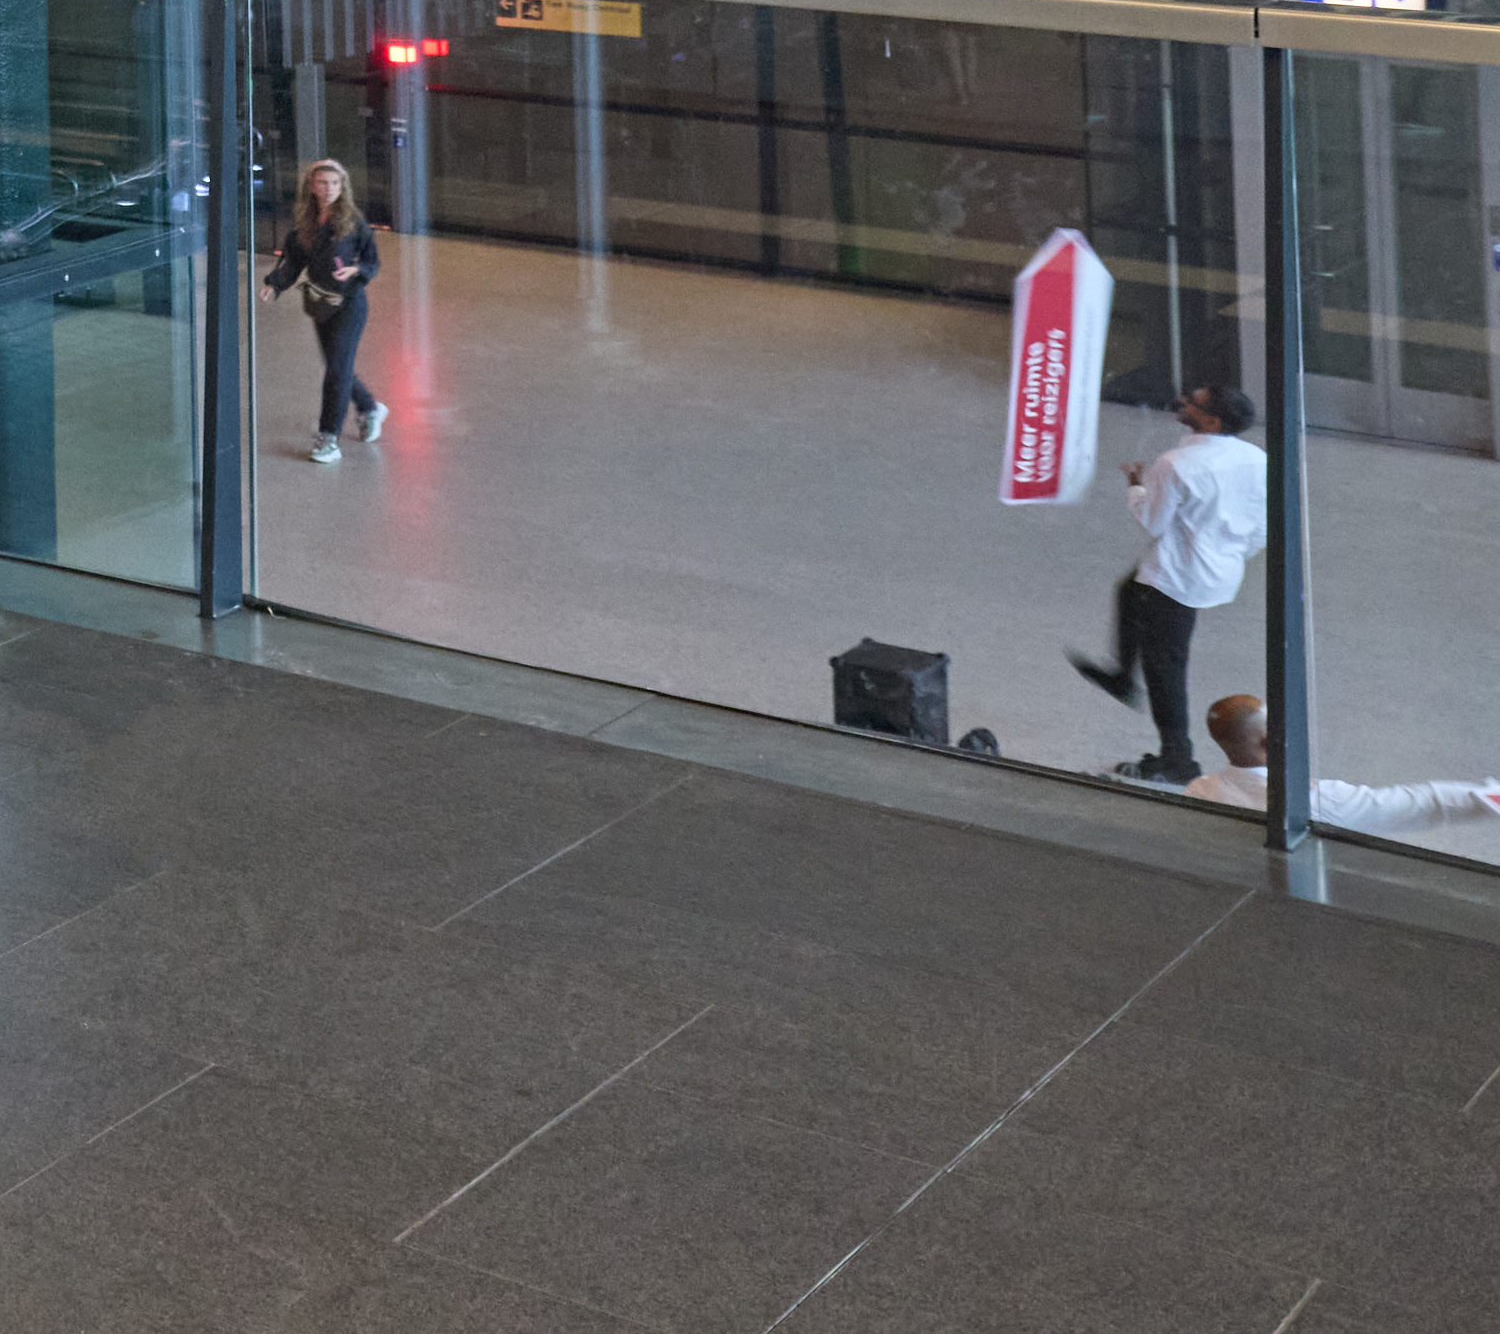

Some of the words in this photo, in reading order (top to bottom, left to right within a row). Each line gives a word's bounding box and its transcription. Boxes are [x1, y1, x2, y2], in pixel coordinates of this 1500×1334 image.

[1021, 341, 1045, 417] ruimte
[1040, 327, 1067, 425] reizigers
[1013, 423, 1038, 483] Meer
[1034, 430, 1056, 483] voor
